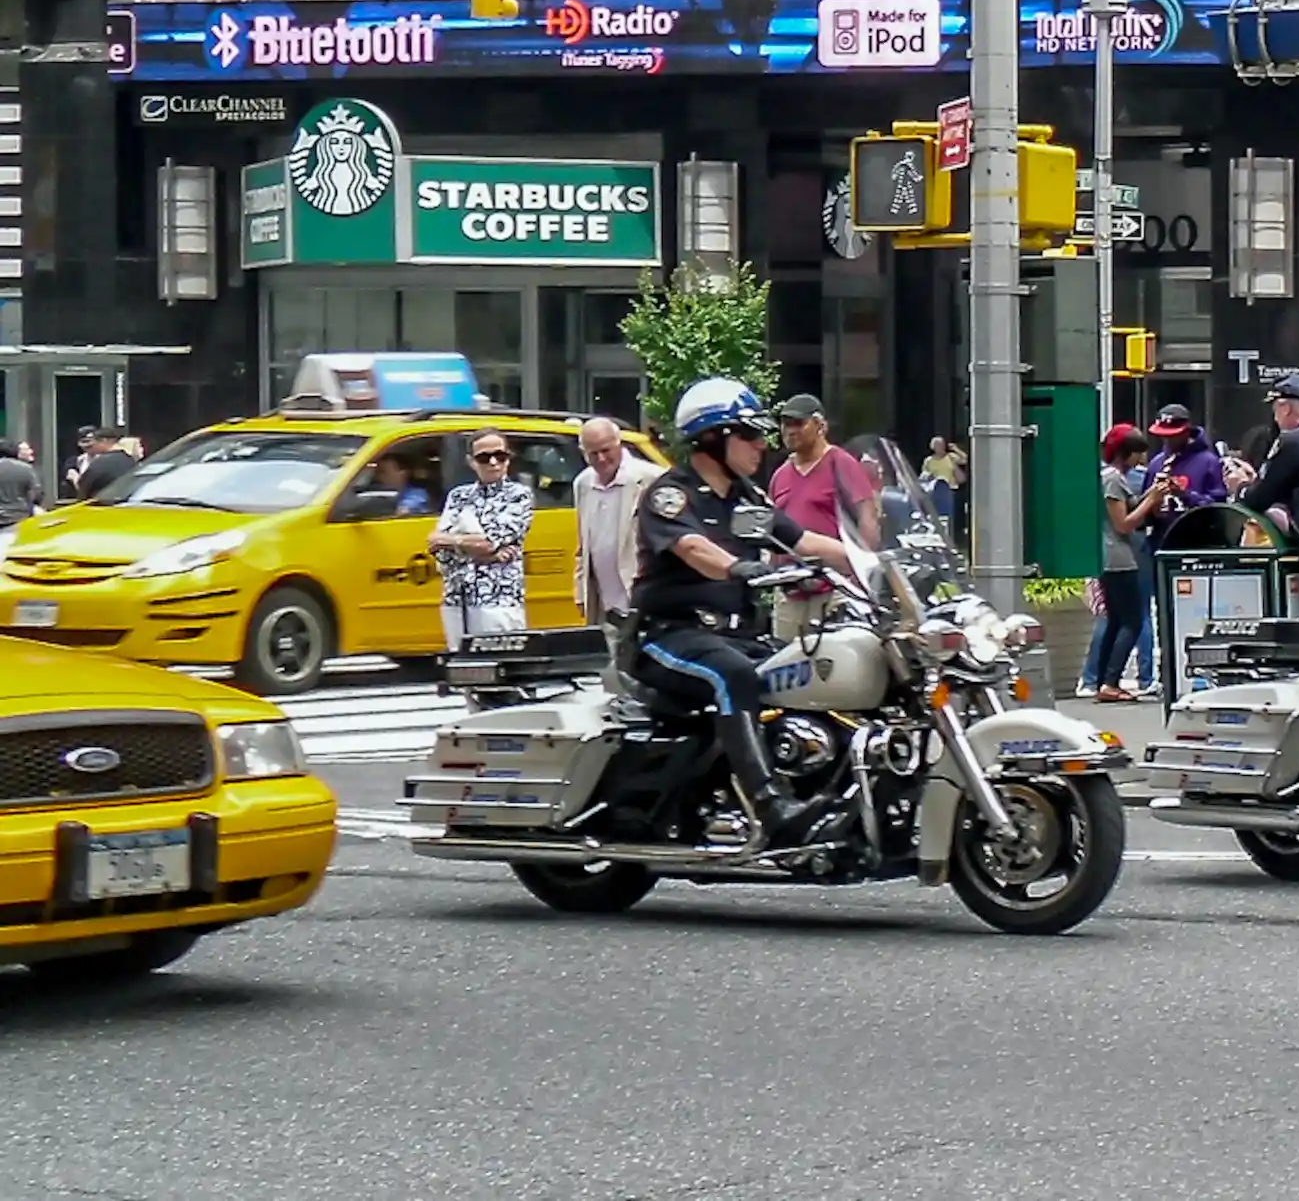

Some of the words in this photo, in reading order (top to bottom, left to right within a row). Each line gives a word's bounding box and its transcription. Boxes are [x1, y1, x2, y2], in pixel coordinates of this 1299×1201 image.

[591, 4, 673, 36] Radio
[868, 9, 905, 23] Made
[908, 8, 928, 23] for
[252, 13, 436, 65] Bluetooth
[867, 26, 926, 54] iPod
[1035, 38, 1060, 53] HD
[1064, 35, 1154, 51] NETORK
[418, 181, 649, 213] STARBUCKS
[461, 213, 610, 242] COFFEE
[1210, 620, 1260, 636] POLICE
[468, 634, 528, 652] POLICE
